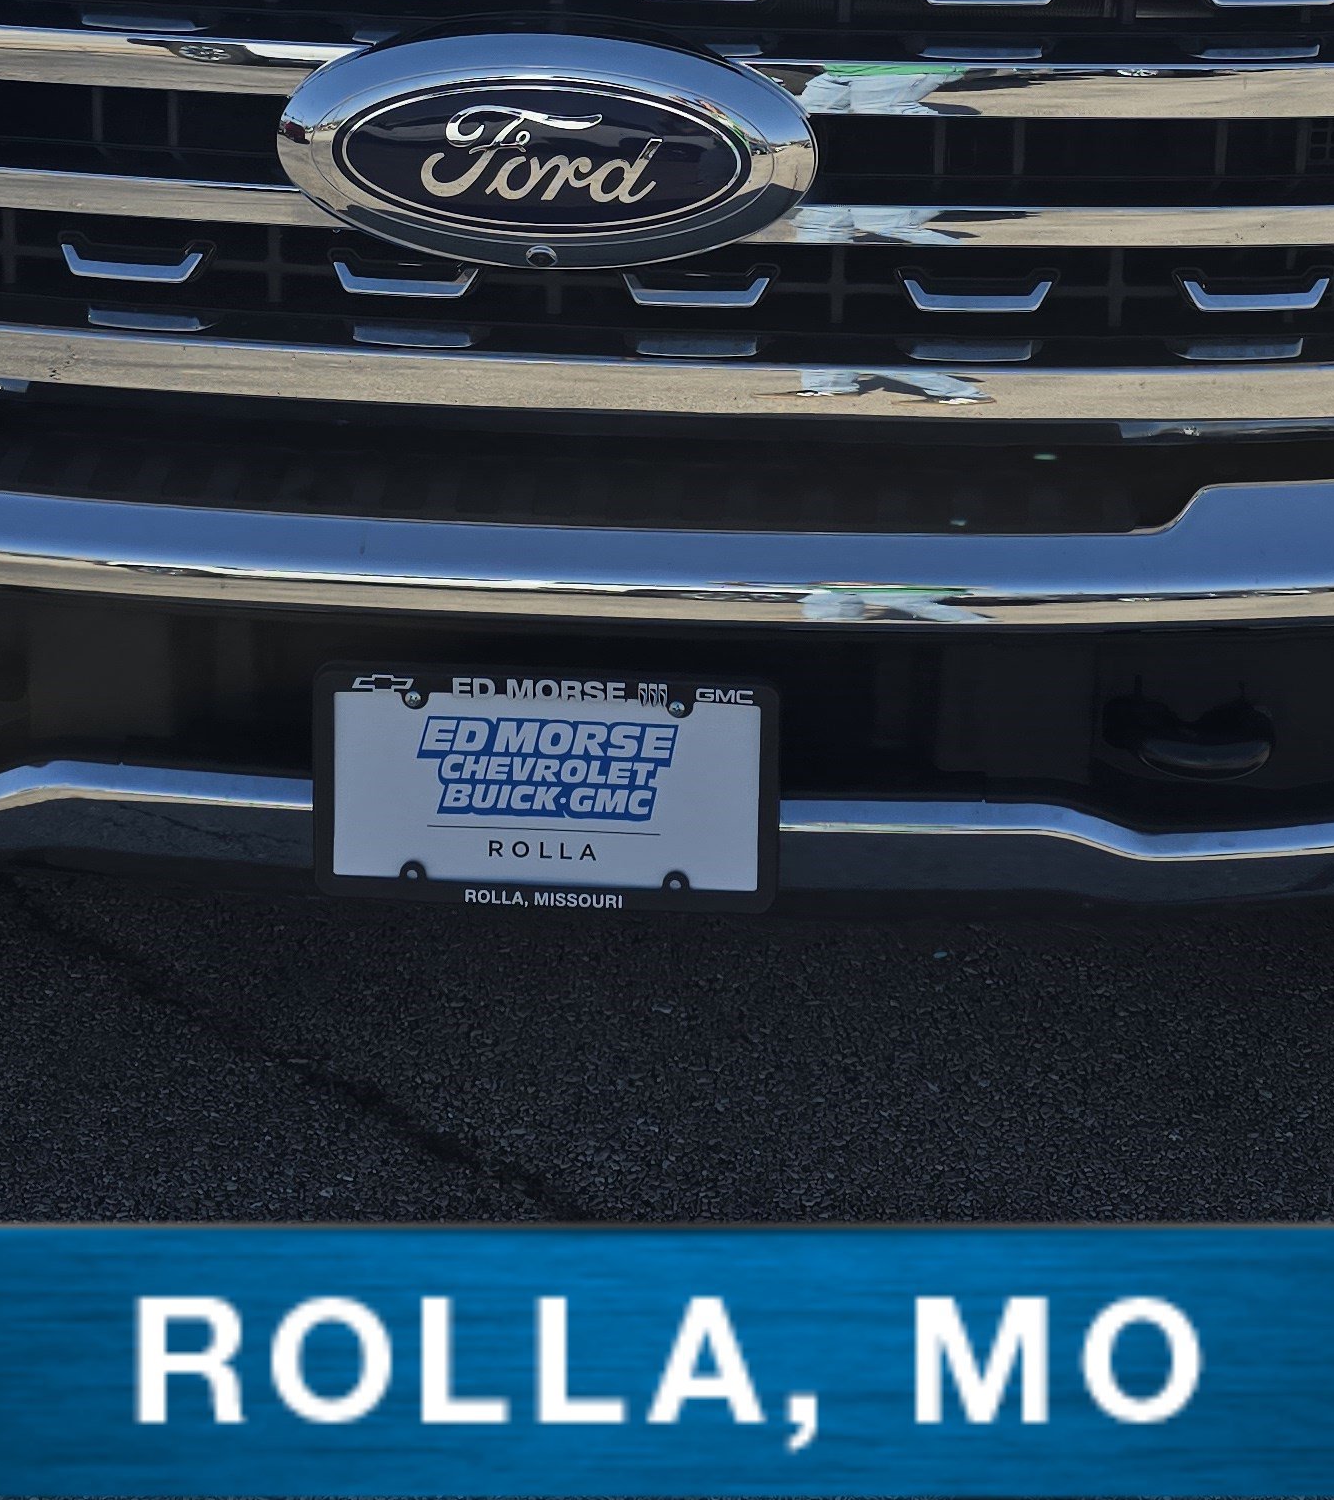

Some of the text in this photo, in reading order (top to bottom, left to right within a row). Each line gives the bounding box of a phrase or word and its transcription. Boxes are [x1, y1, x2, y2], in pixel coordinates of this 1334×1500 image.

[420, 104, 663, 204] Ford
[451, 677, 754, 704] ED MORSE GMC
[422, 718, 675, 759] ED MORSE
[441, 753, 655, 786] CHEVROLET
[488, 840, 597, 861] ROLLA
[464, 889, 623, 909] ROLLA, MISSOURI
